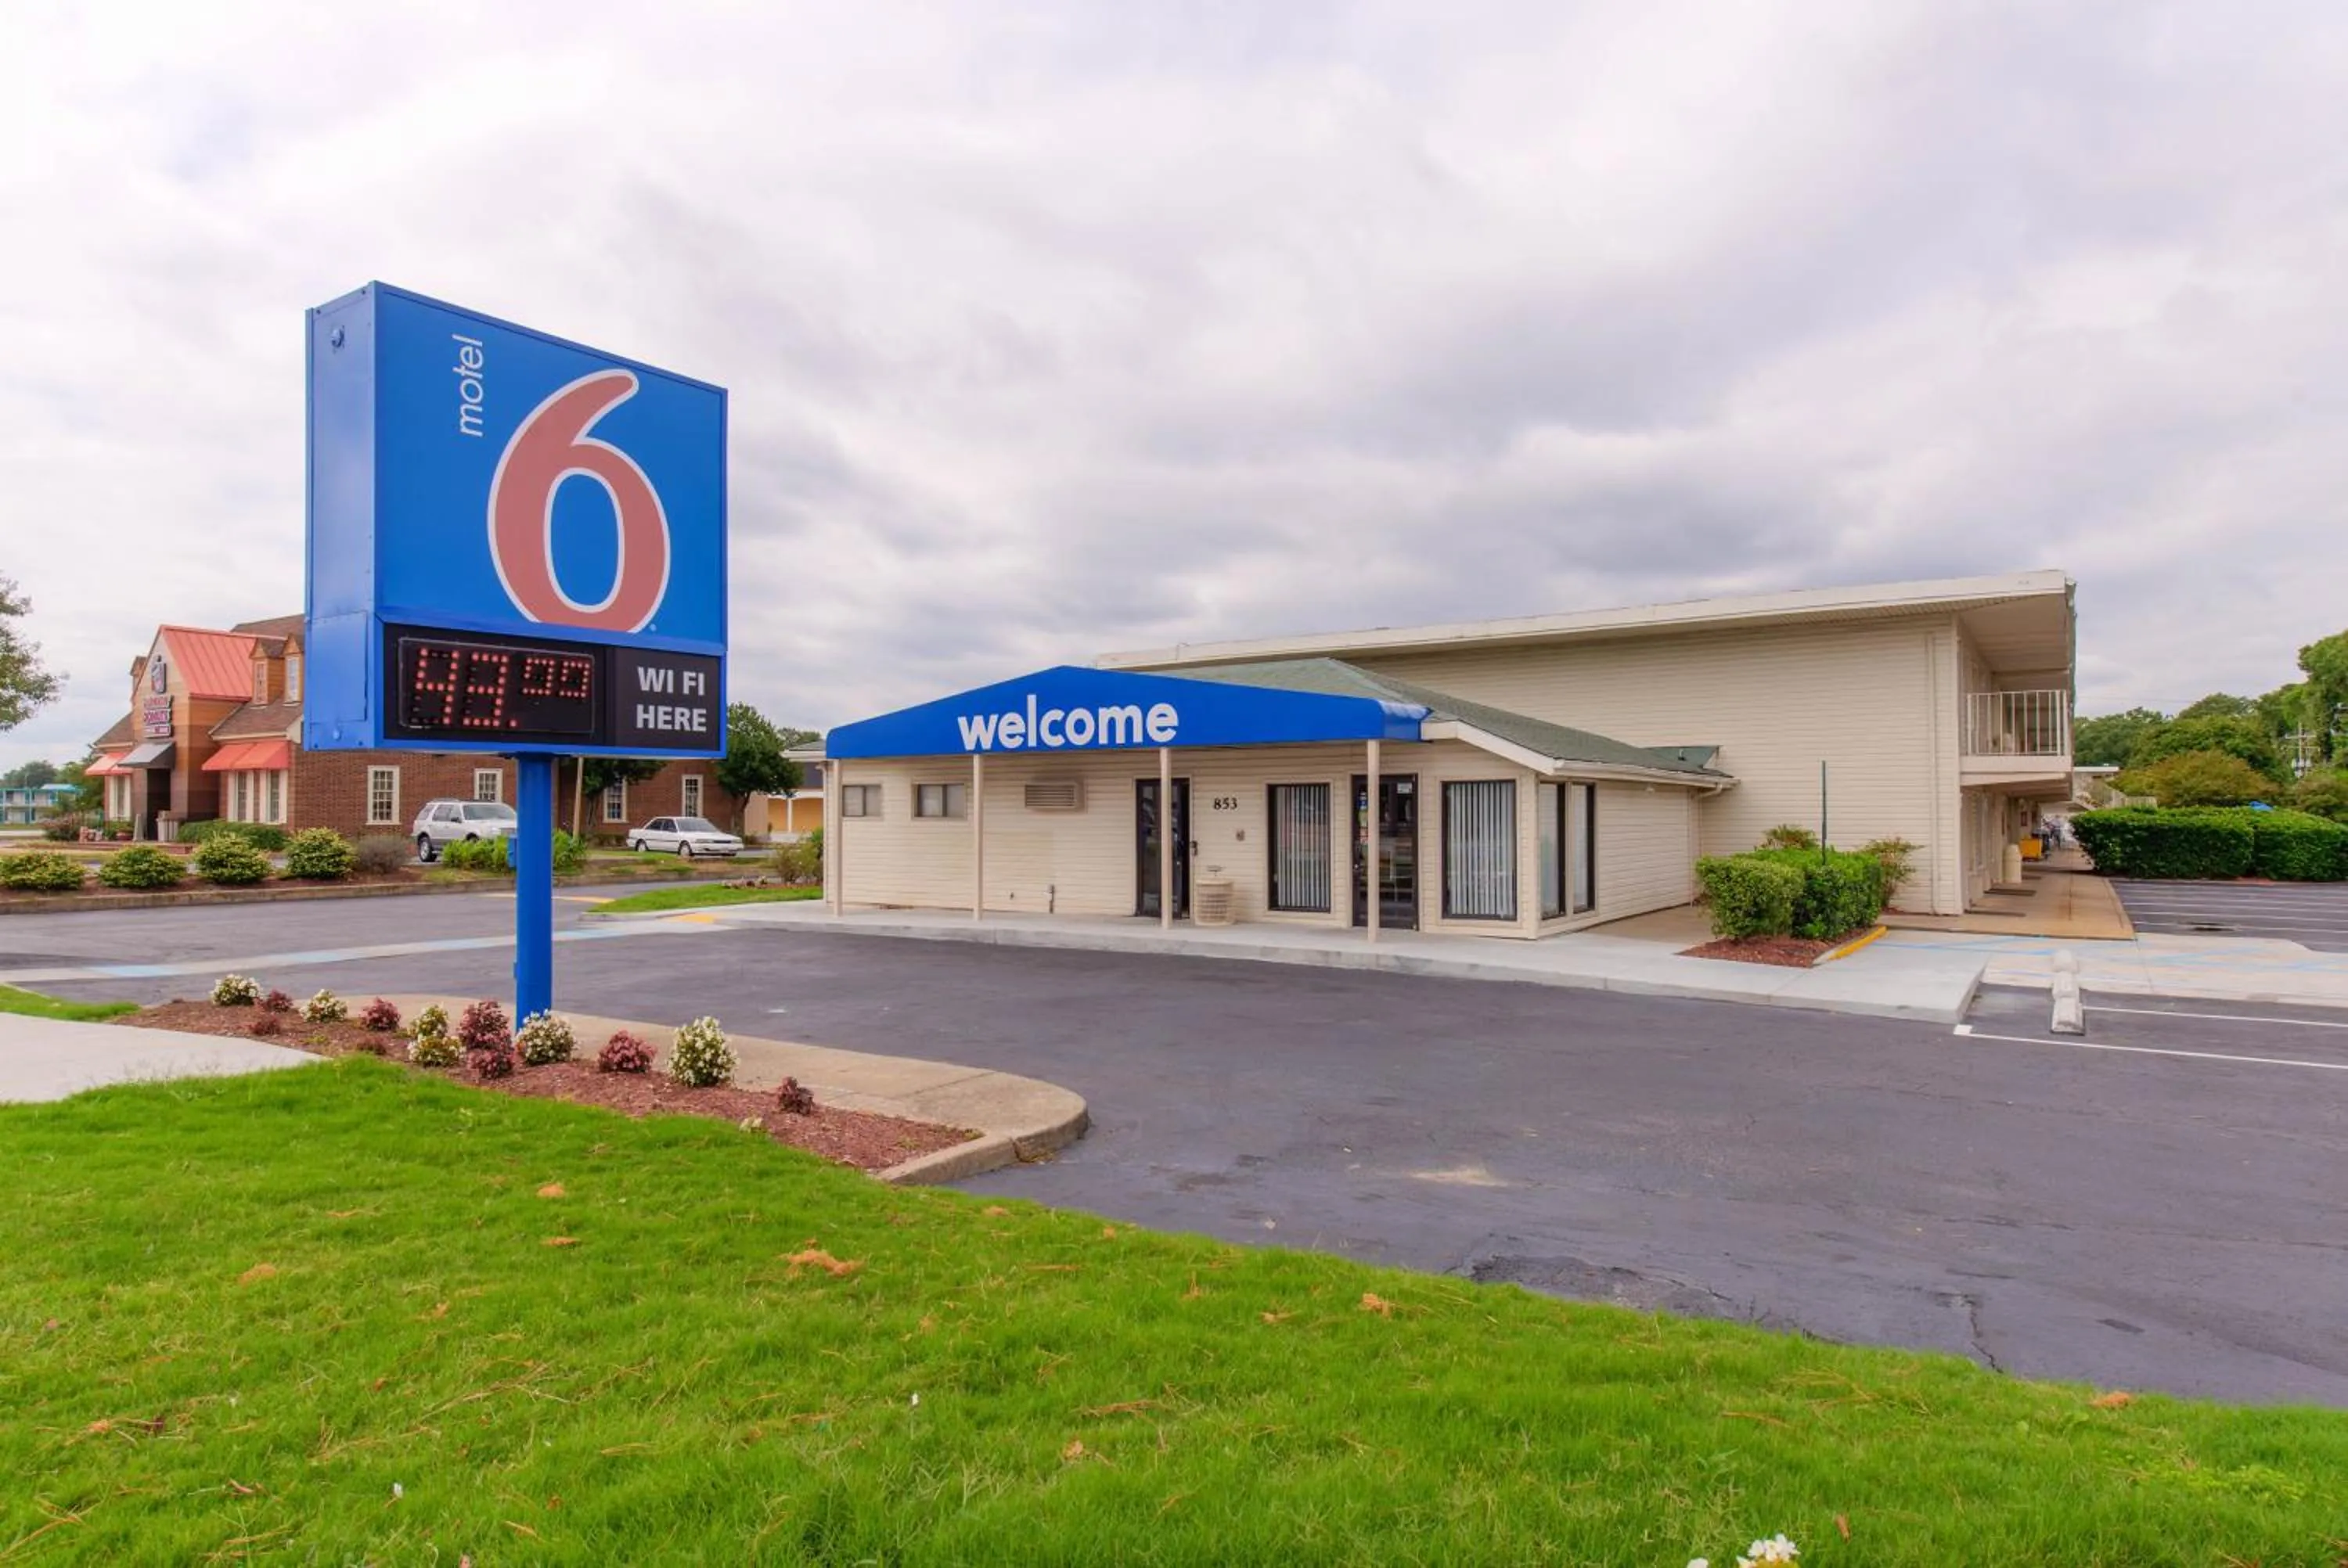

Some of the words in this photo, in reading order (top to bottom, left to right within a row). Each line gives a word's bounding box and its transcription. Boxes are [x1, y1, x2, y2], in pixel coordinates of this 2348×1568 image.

[452, 333, 484, 437] motel
[487, 369, 671, 633] 6
[637, 666, 674, 694] WI
[682, 670, 705, 696] FI
[636, 703, 708, 732] HERE
[957, 694, 1179, 750] welcome
[1214, 797, 1237, 811] 853
